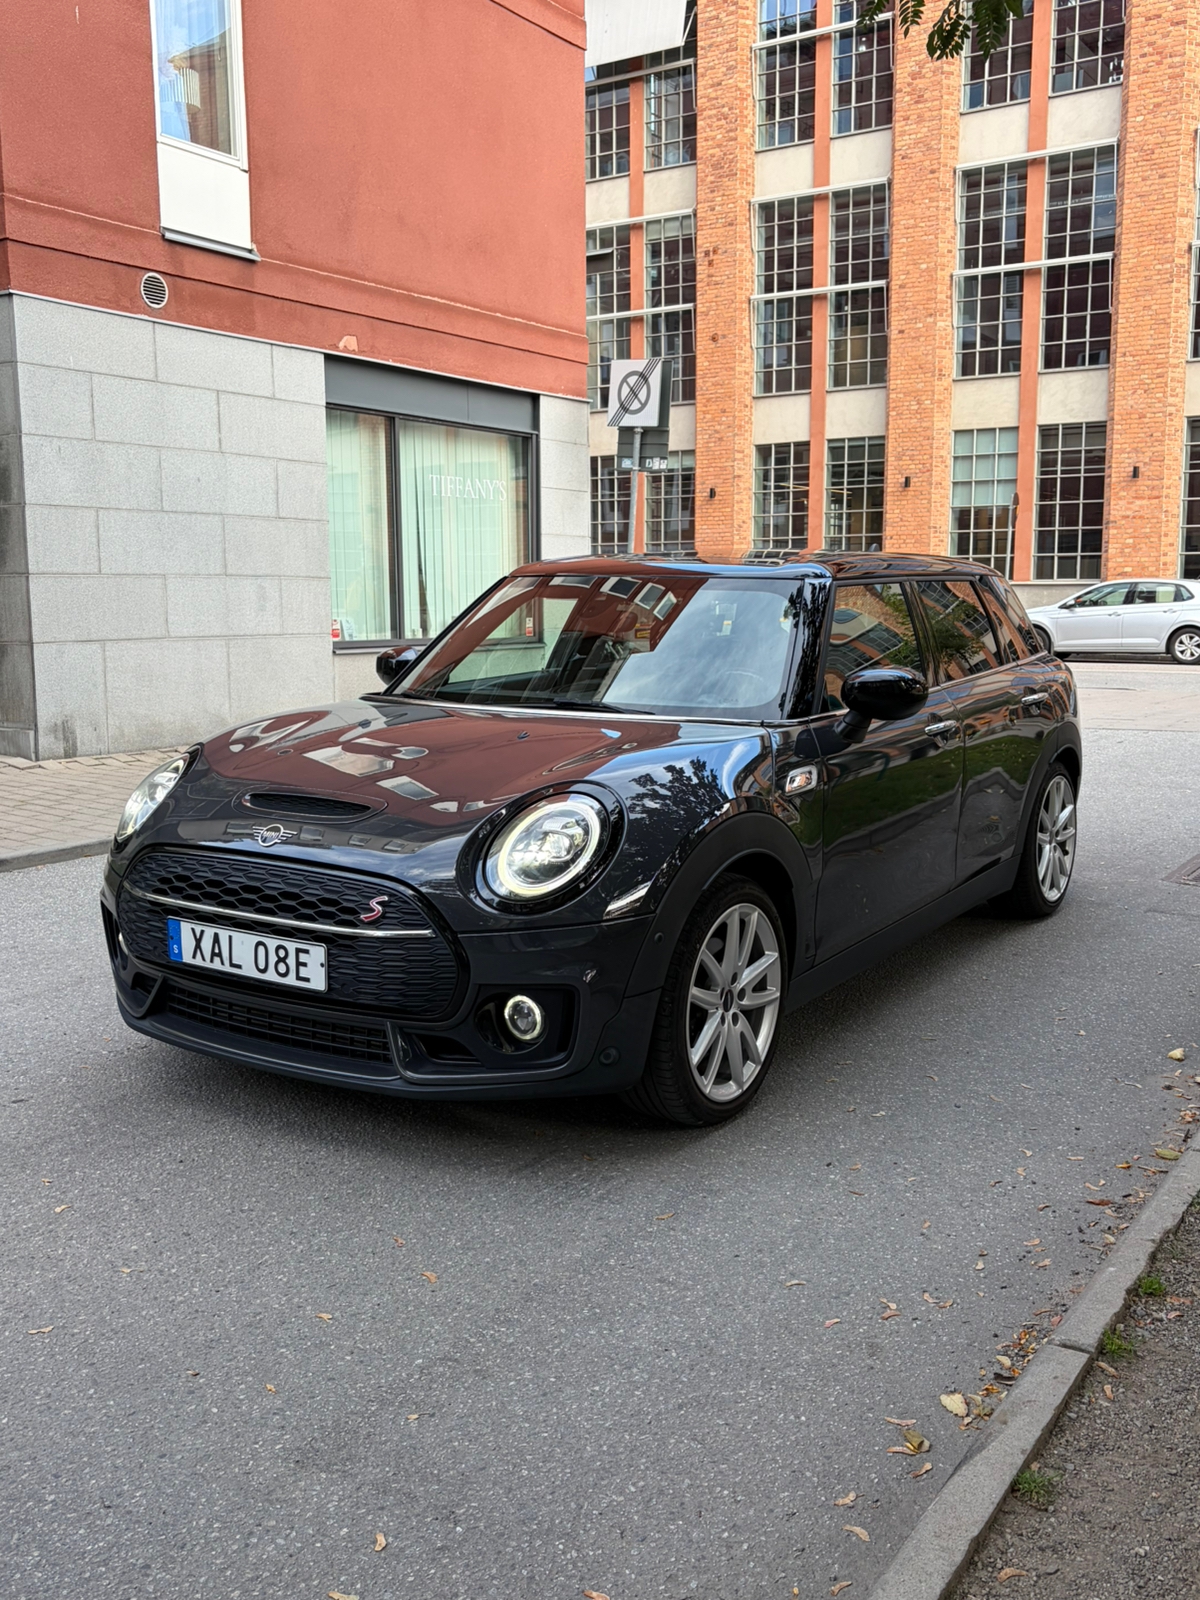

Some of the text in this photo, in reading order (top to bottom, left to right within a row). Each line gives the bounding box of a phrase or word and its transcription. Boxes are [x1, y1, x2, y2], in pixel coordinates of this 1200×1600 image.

[429, 474, 507, 501] TIFFANY'S
[360, 895, 389, 923] S
[173, 944, 179, 954] S
[190, 927, 311, 984] XAL 08E
